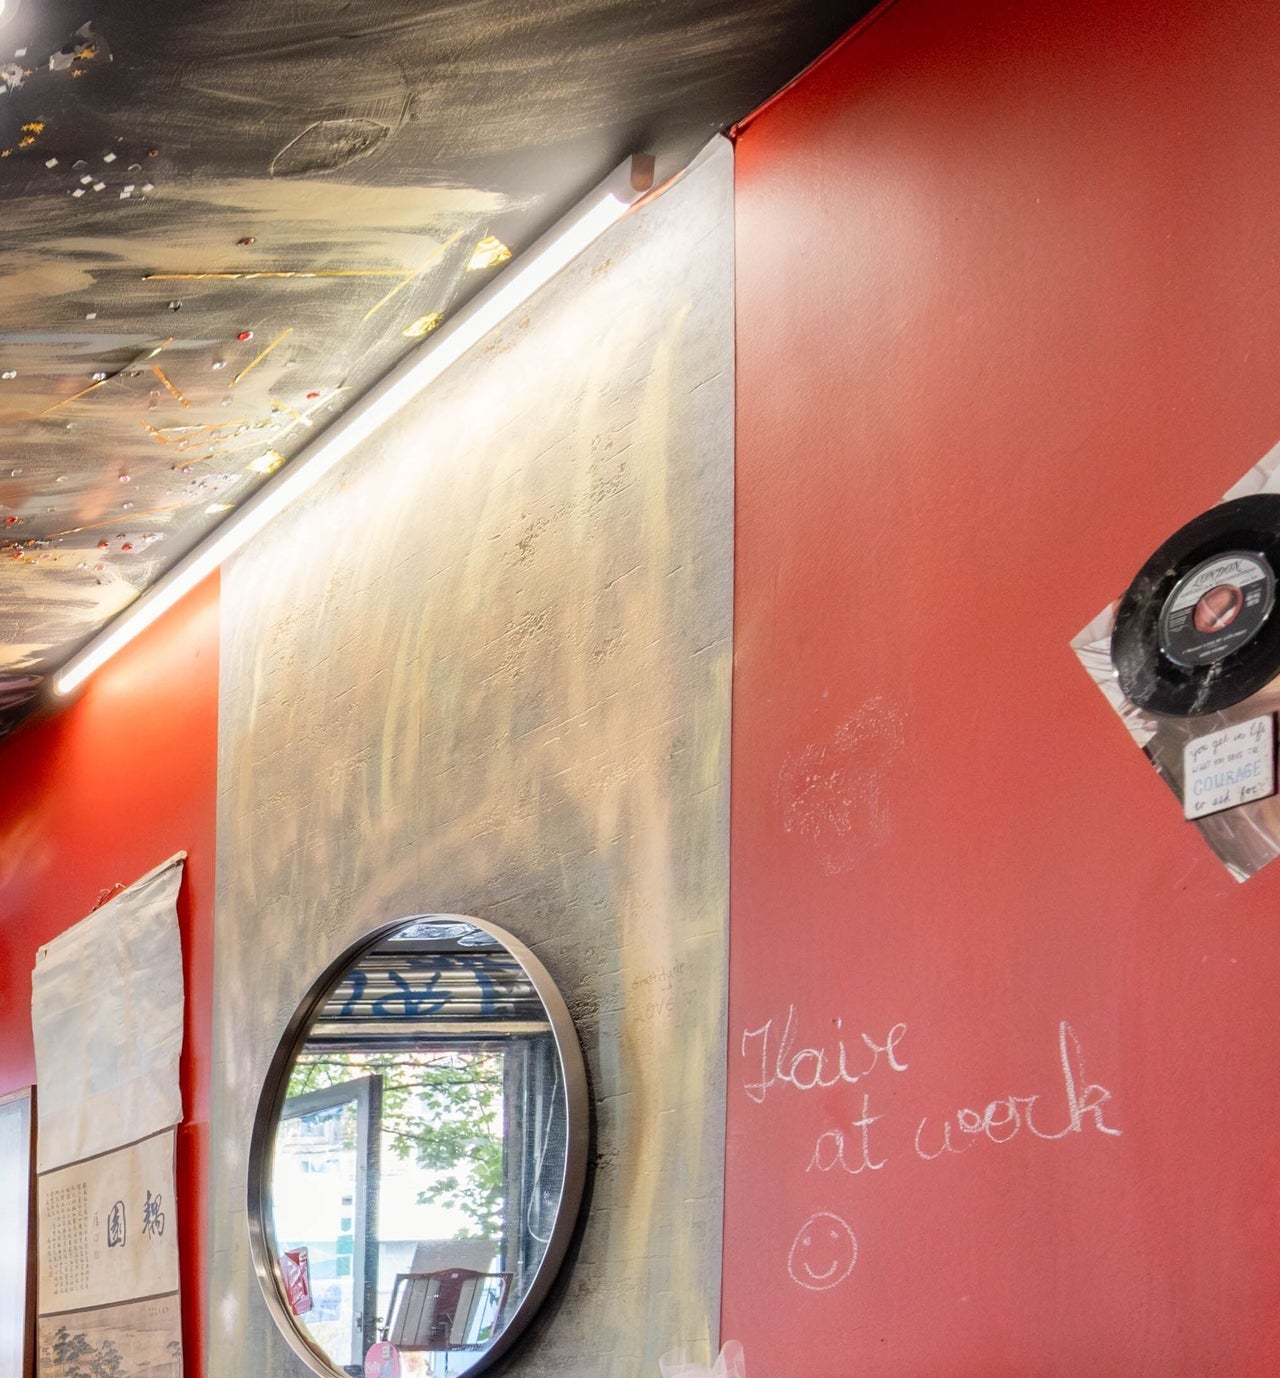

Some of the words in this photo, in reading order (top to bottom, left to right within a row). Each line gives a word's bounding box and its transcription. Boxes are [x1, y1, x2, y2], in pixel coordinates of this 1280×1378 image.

[1193, 760, 1262, 797] COURAGE
[742, 1003, 910, 1103] Hair
[805, 1095, 885, 1174] at
[915, 1020, 1124, 1161] work
